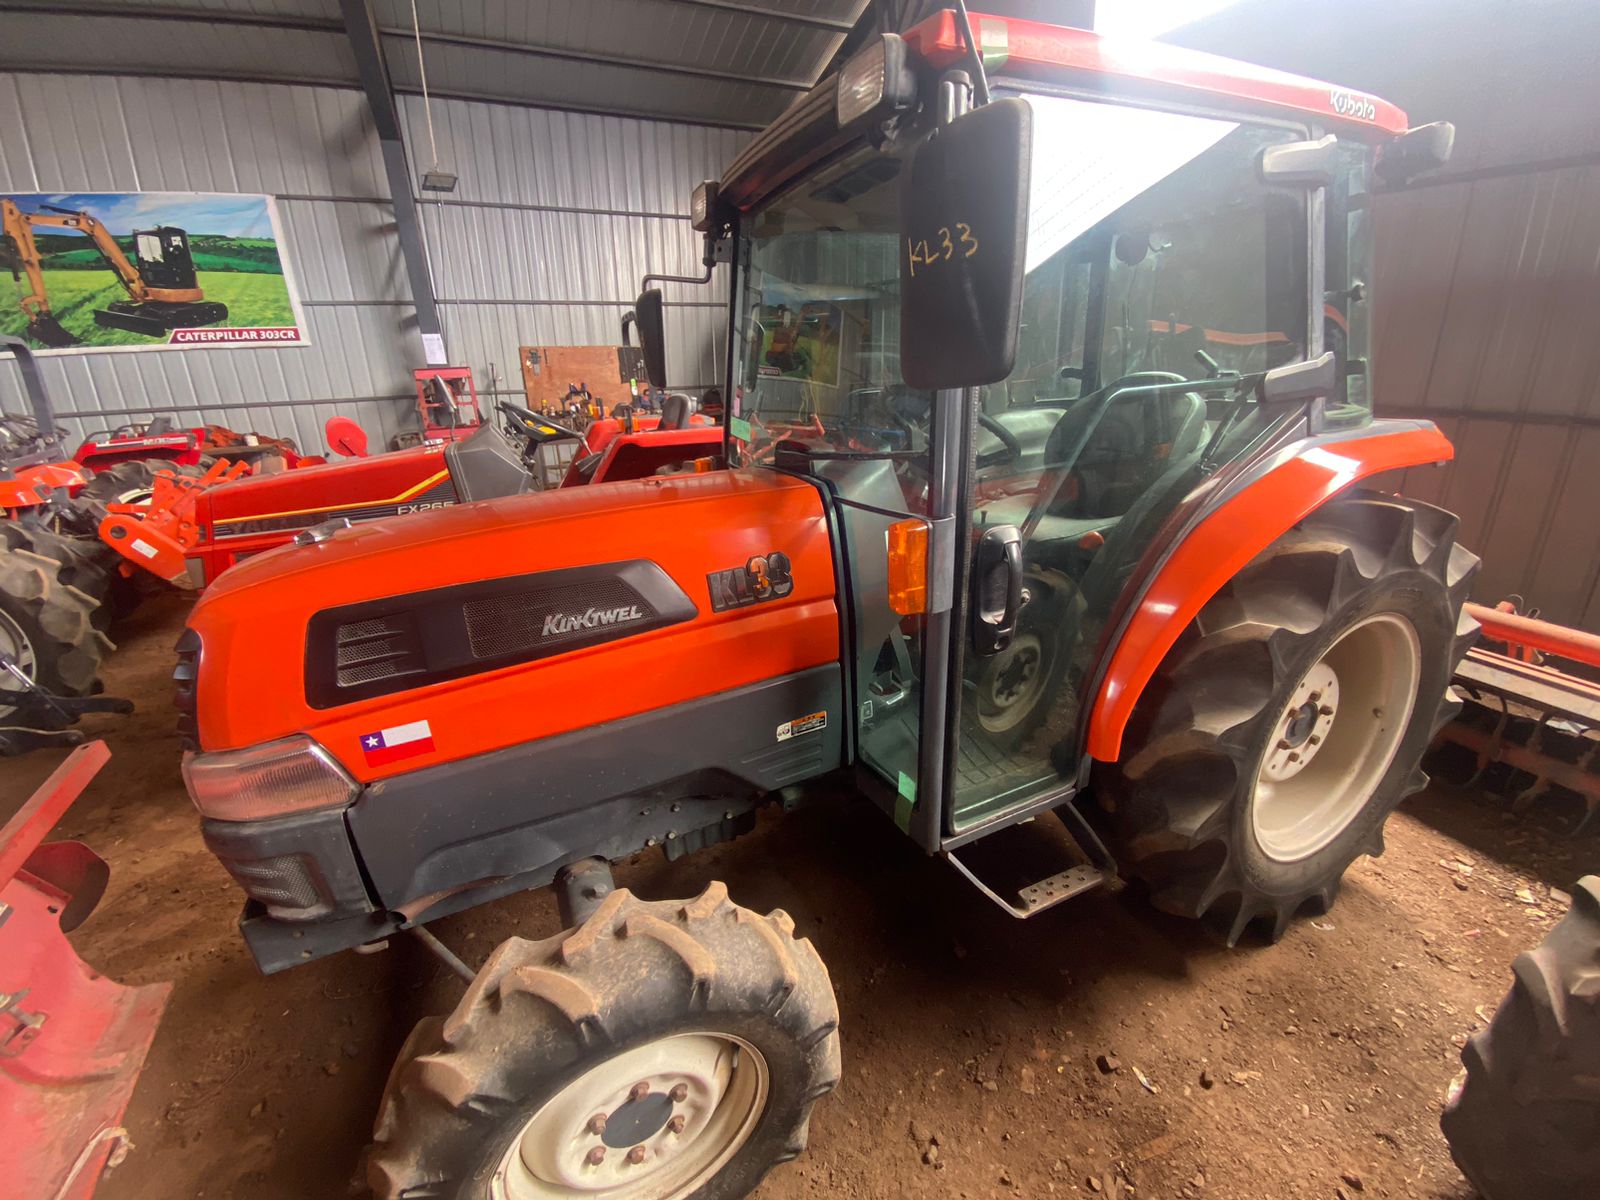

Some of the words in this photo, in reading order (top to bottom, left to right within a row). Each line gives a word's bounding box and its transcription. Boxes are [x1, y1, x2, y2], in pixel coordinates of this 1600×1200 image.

[1329, 90, 1376, 121] Kubota
[908, 223, 978, 277] KL33
[177, 331, 258, 341] CATERPILLAR
[259, 330, 296, 340] 303CR
